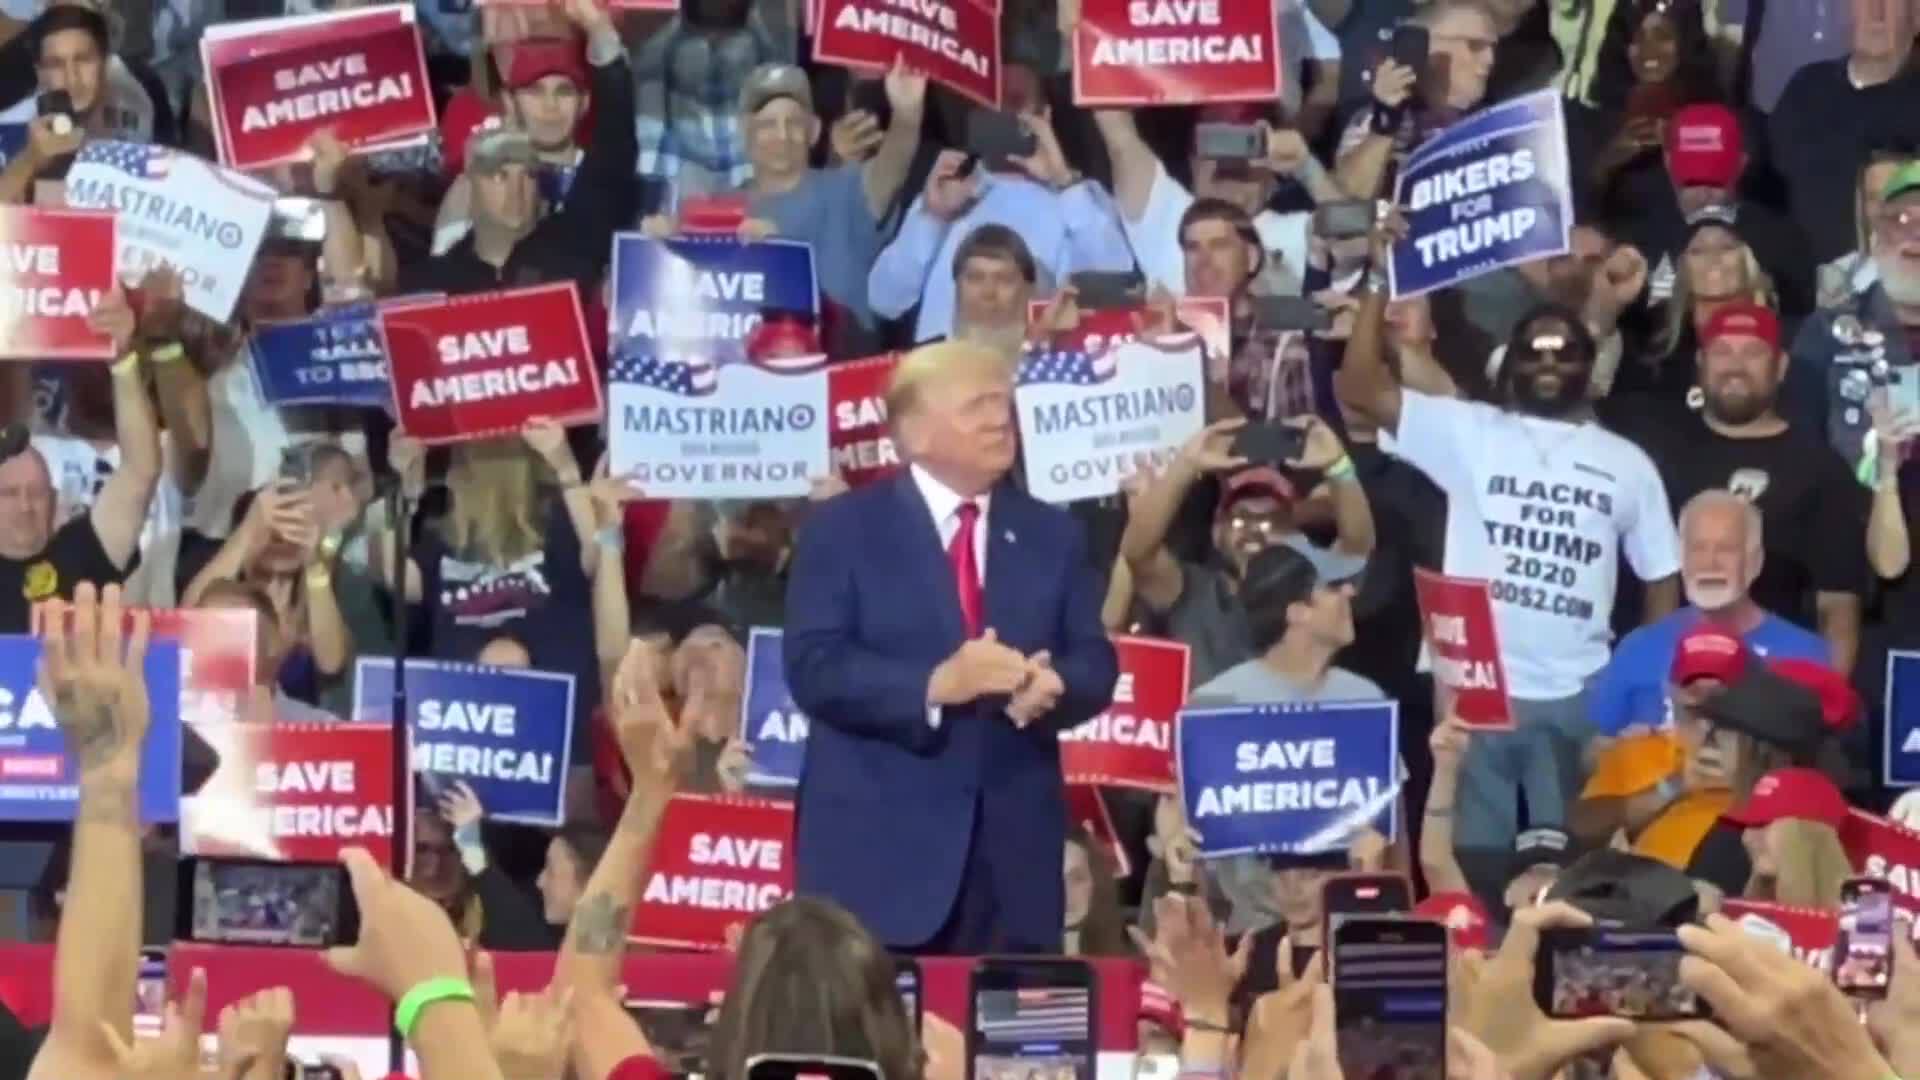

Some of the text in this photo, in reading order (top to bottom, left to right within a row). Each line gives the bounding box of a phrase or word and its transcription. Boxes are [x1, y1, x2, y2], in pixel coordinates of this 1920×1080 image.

[1129, 0, 1221, 27] SAVE
[834, 4, 989, 78] AMERICA!
[1092, 34, 1263, 65] AMERICA!
[274, 52, 367, 91] SAVE
[241, 73, 414, 134] AMERICA!
[1410, 148, 1536, 210] BIKERS
[71, 178, 244, 249] MASTRIANO
[1450, 193, 1494, 221] FOR
[1414, 207, 1537, 268] TRUMP
[694, 272, 766, 302] AVE
[437, 326, 531, 365] SAVE
[410, 356, 580, 410] AMERICA!
[623, 403, 817, 436] MASTRIANO
[1033, 383, 1196, 434] MASTRIANO
[1487, 474, 1614, 516] BLACKS
[1519, 504, 1577, 528] FOR
[1483, 520, 1604, 566] TRUMP
[1504, 553, 1578, 588] 2020
[417, 699, 516, 736] SAVE
[1235, 738, 1336, 772] SAVE
[255, 761, 355, 793] SAVE
[1194, 777, 1380, 817] AMERICA!
[689, 834, 783, 871] SAVE
[643, 873, 794, 914] AMERIC
